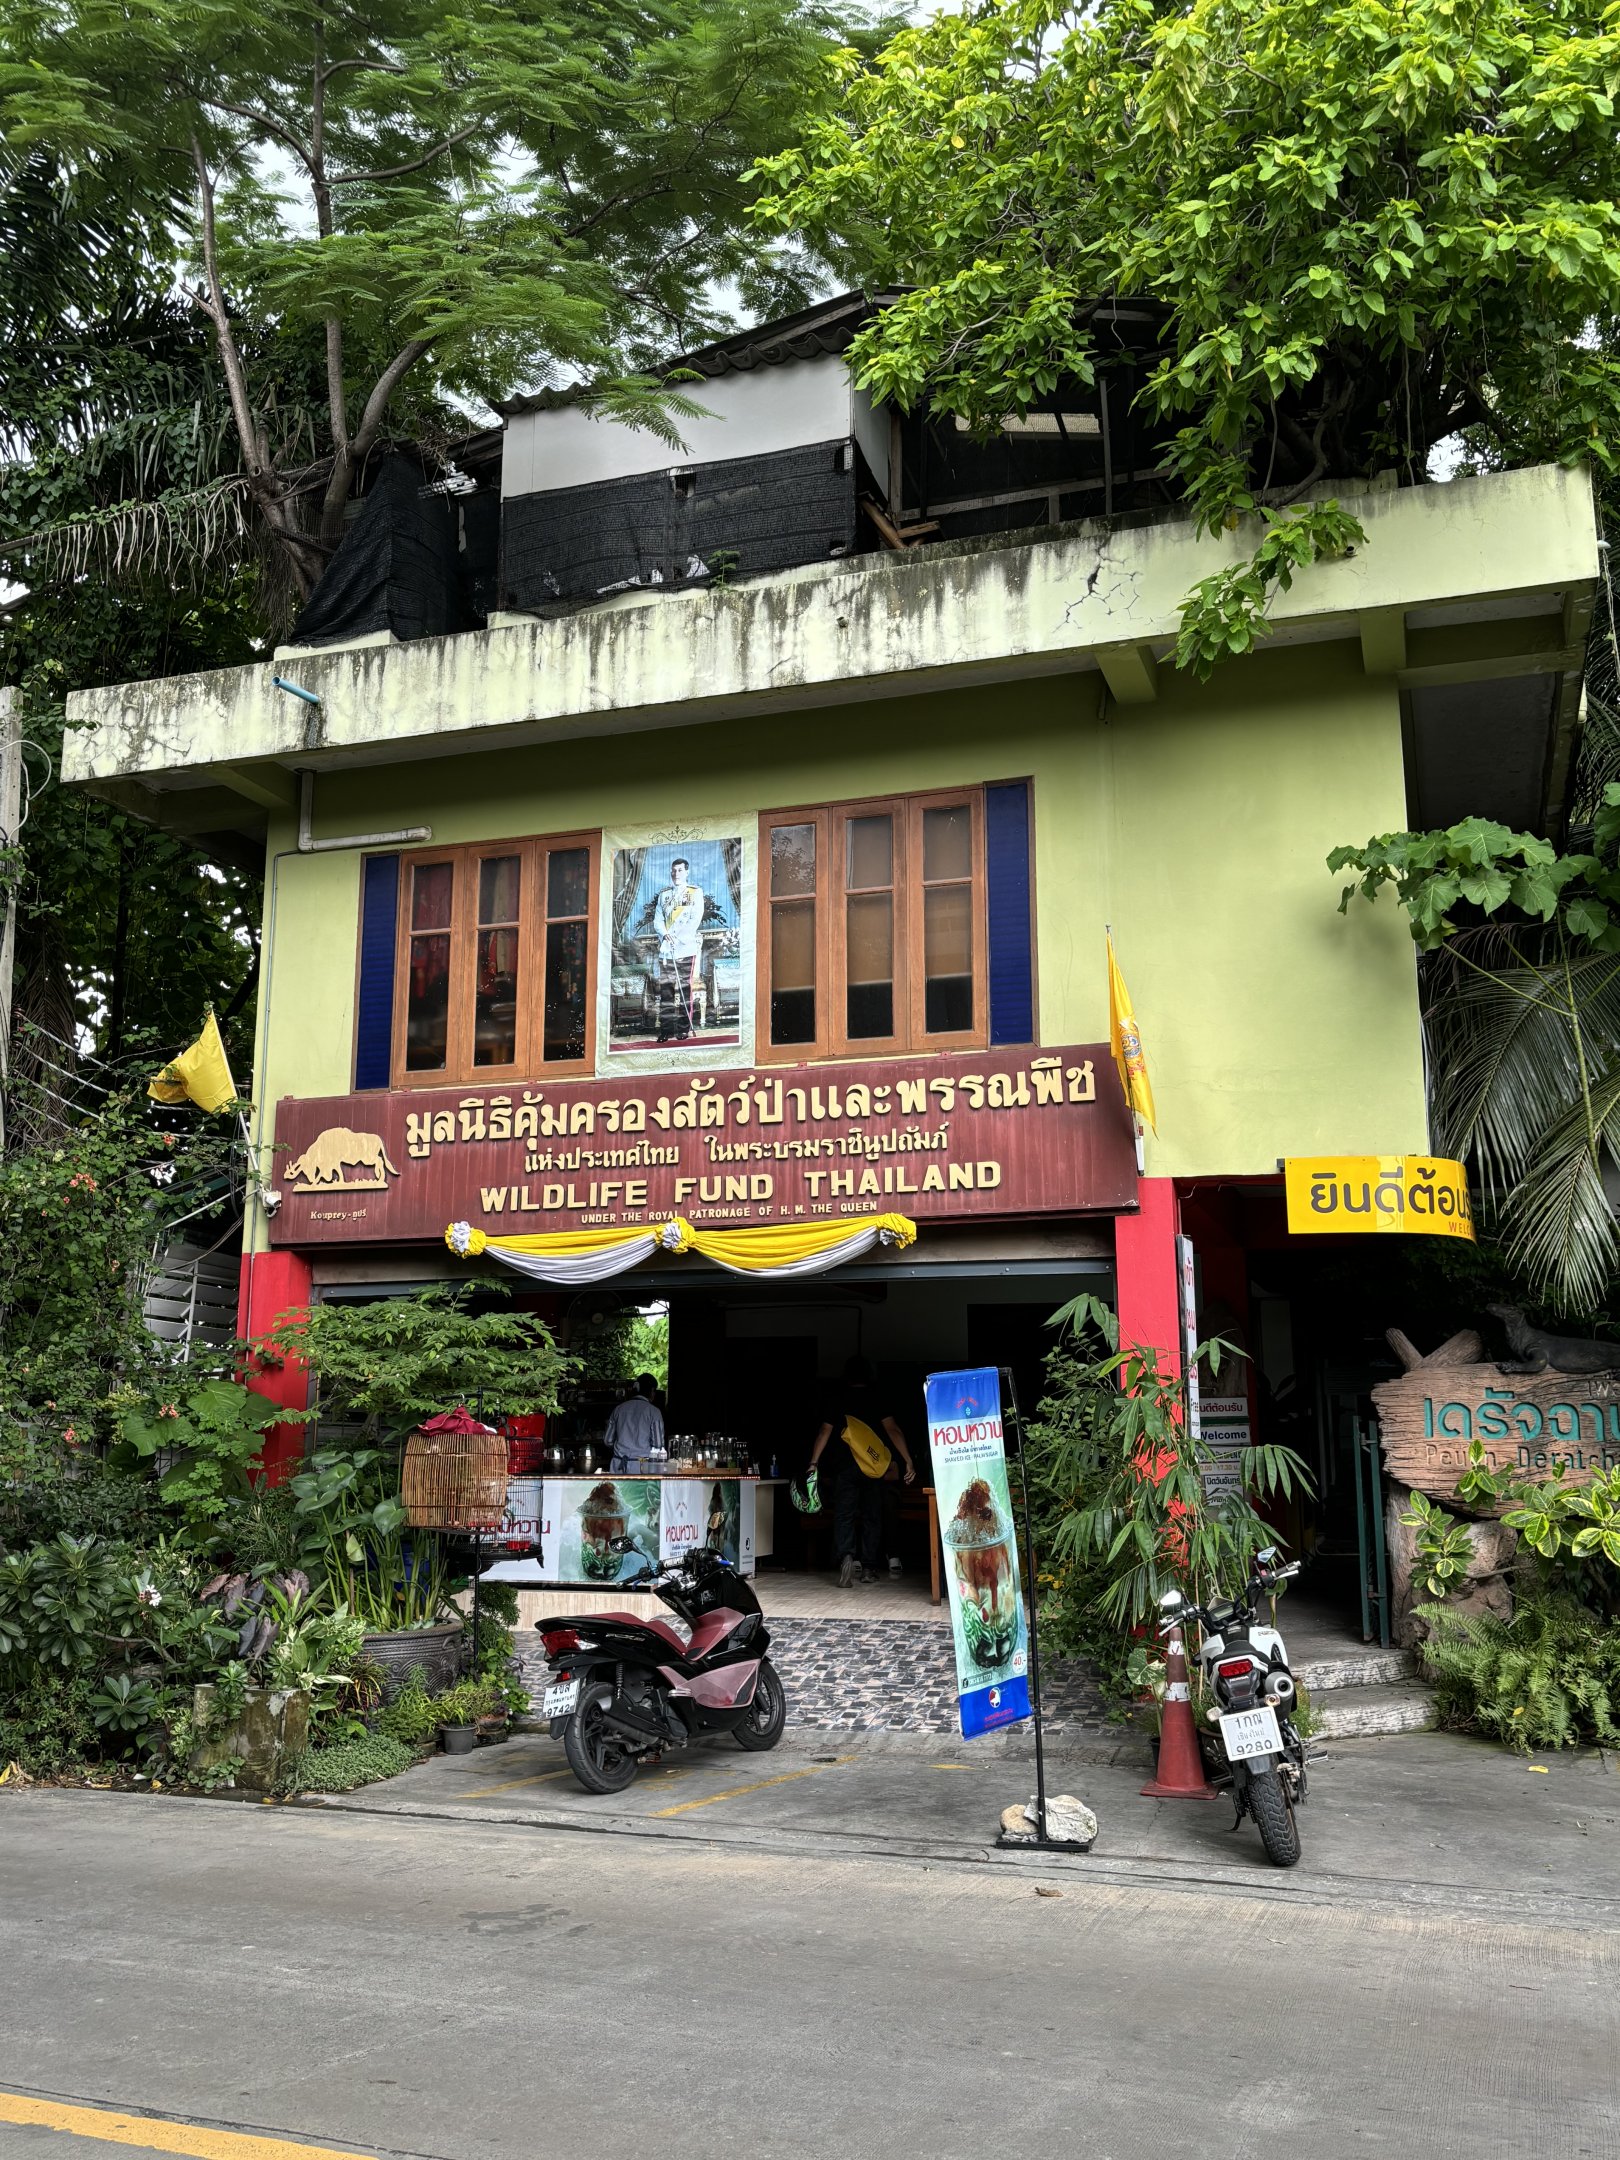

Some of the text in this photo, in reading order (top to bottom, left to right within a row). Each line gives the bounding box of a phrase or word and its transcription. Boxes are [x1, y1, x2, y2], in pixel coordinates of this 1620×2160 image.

[525, 1121, 949, 1173] แห่งประเทศไทย ในพระบรมราชินูปถัมภ์
[480, 1160, 1001, 1213] WILDLIFE FUND THAILAND
[581, 1213, 616, 1224] UNDER
[621, 1211, 642, 1222] THE
[689, 1207, 751, 1219] PATRONAGE
[758, 1205, 773, 1216] OF
[811, 1203, 833, 1214] THE
[840, 1201, 877, 1212] QUEEN
[933, 1420, 1003, 1447] หอมหวาน
[1425, 1443, 1620, 1470] Peun Deratch
[665, 1523, 699, 1543] หอมหวาน
[547, 1704, 570, 1717] 9742
[1236, 1739, 1273, 1756] 9280
